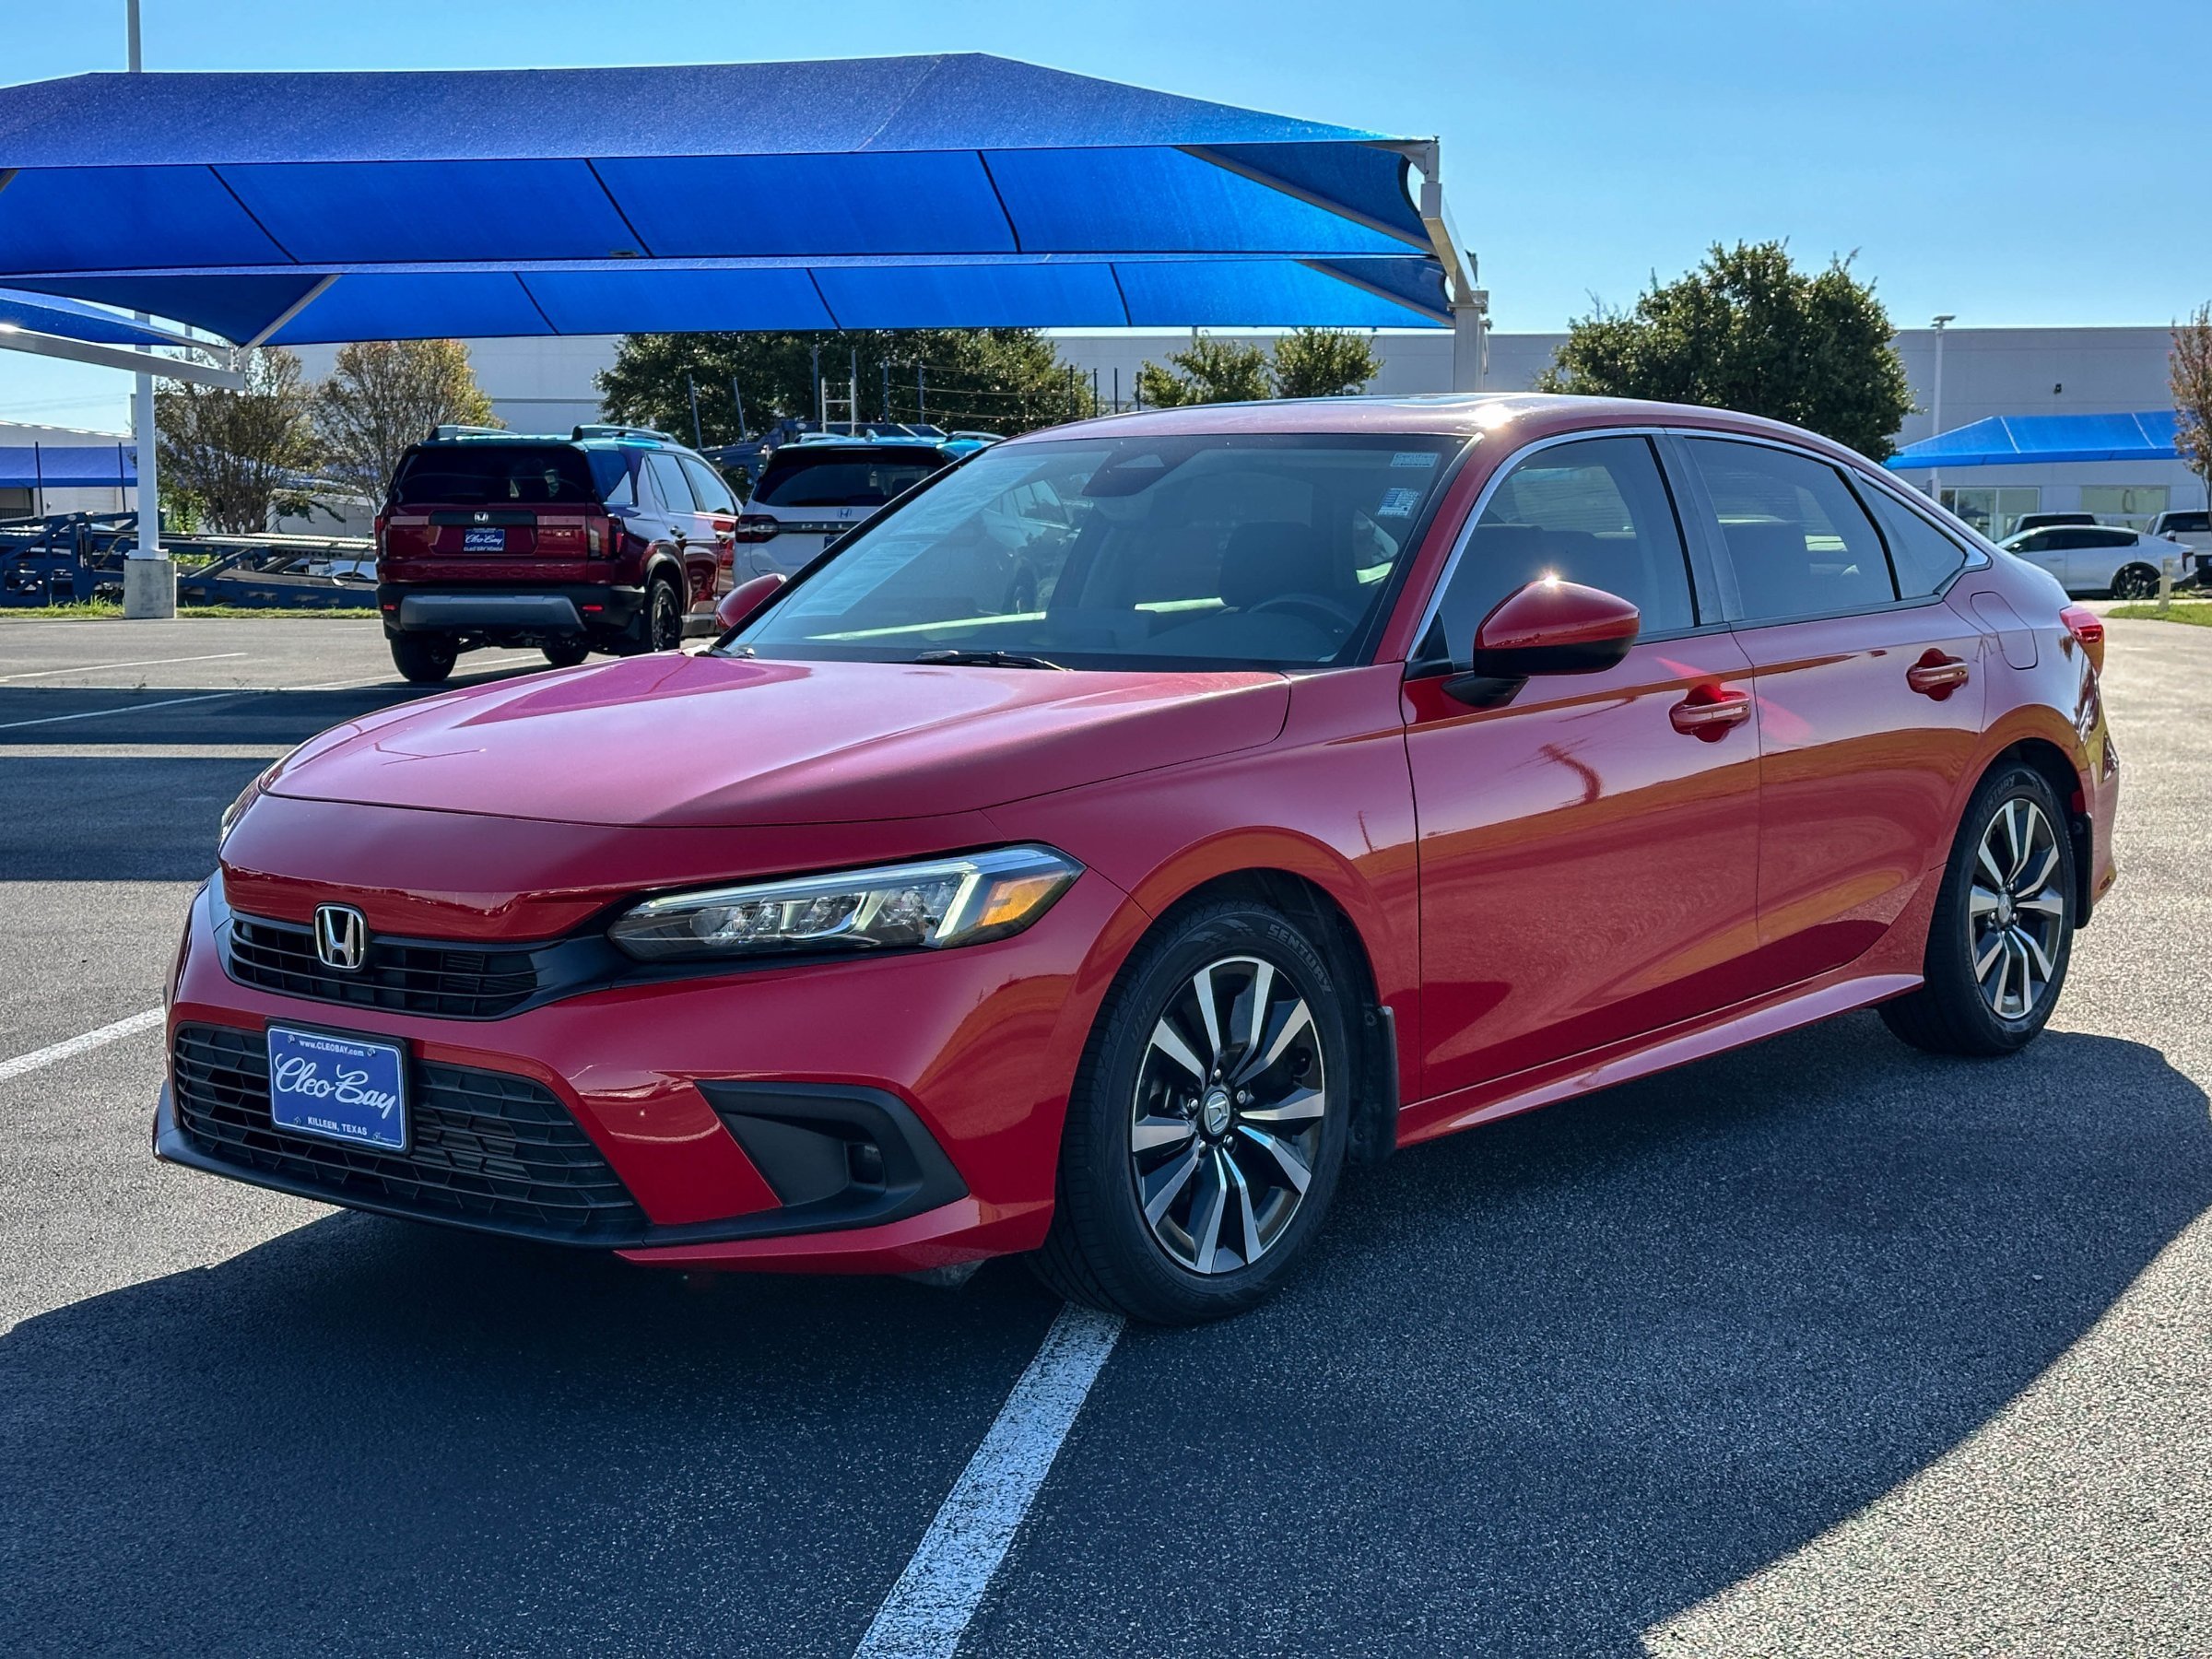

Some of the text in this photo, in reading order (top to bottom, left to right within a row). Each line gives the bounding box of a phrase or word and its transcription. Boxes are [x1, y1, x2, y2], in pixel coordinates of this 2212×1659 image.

[1267, 924, 1332, 995] SENTURY
[300, 1039, 364, 1057] www.CLEOBAY.com
[275, 1053, 396, 1120] Cleo Bay
[307, 1116, 368, 1136] KILLEEN, TEXAS
